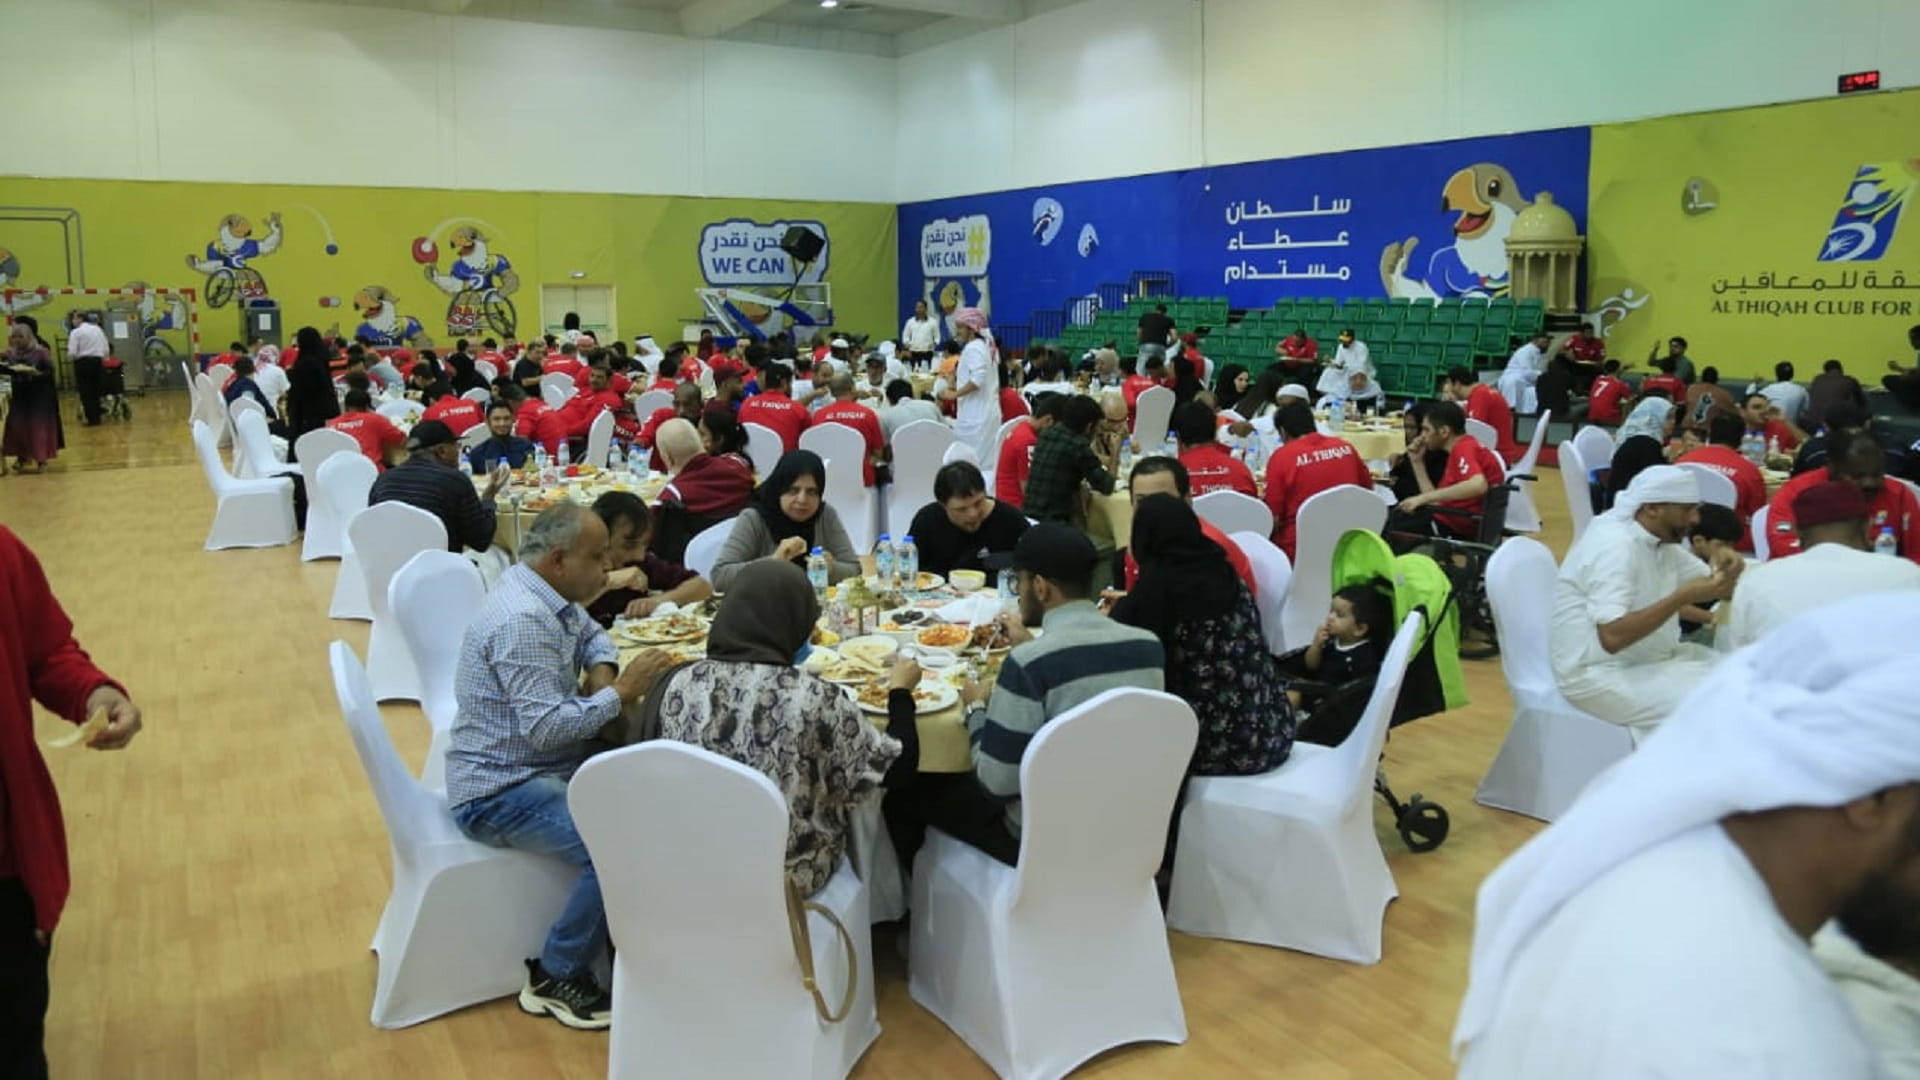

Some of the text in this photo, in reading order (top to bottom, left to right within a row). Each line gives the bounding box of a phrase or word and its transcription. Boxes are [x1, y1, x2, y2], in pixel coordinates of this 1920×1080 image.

[1226, 195, 1351, 225] سلطان
[711, 231, 748, 252] نقدر
[1227, 229, 1349, 250] عطاء
[712, 257, 784, 273] WE CAN
[926, 251, 966, 268] WE CAN
[1224, 259, 1350, 285] مستدام
[1712, 300, 1912, 317] AL THIQAH CLUB FOR
[1594, 380, 1609, 398] 7
